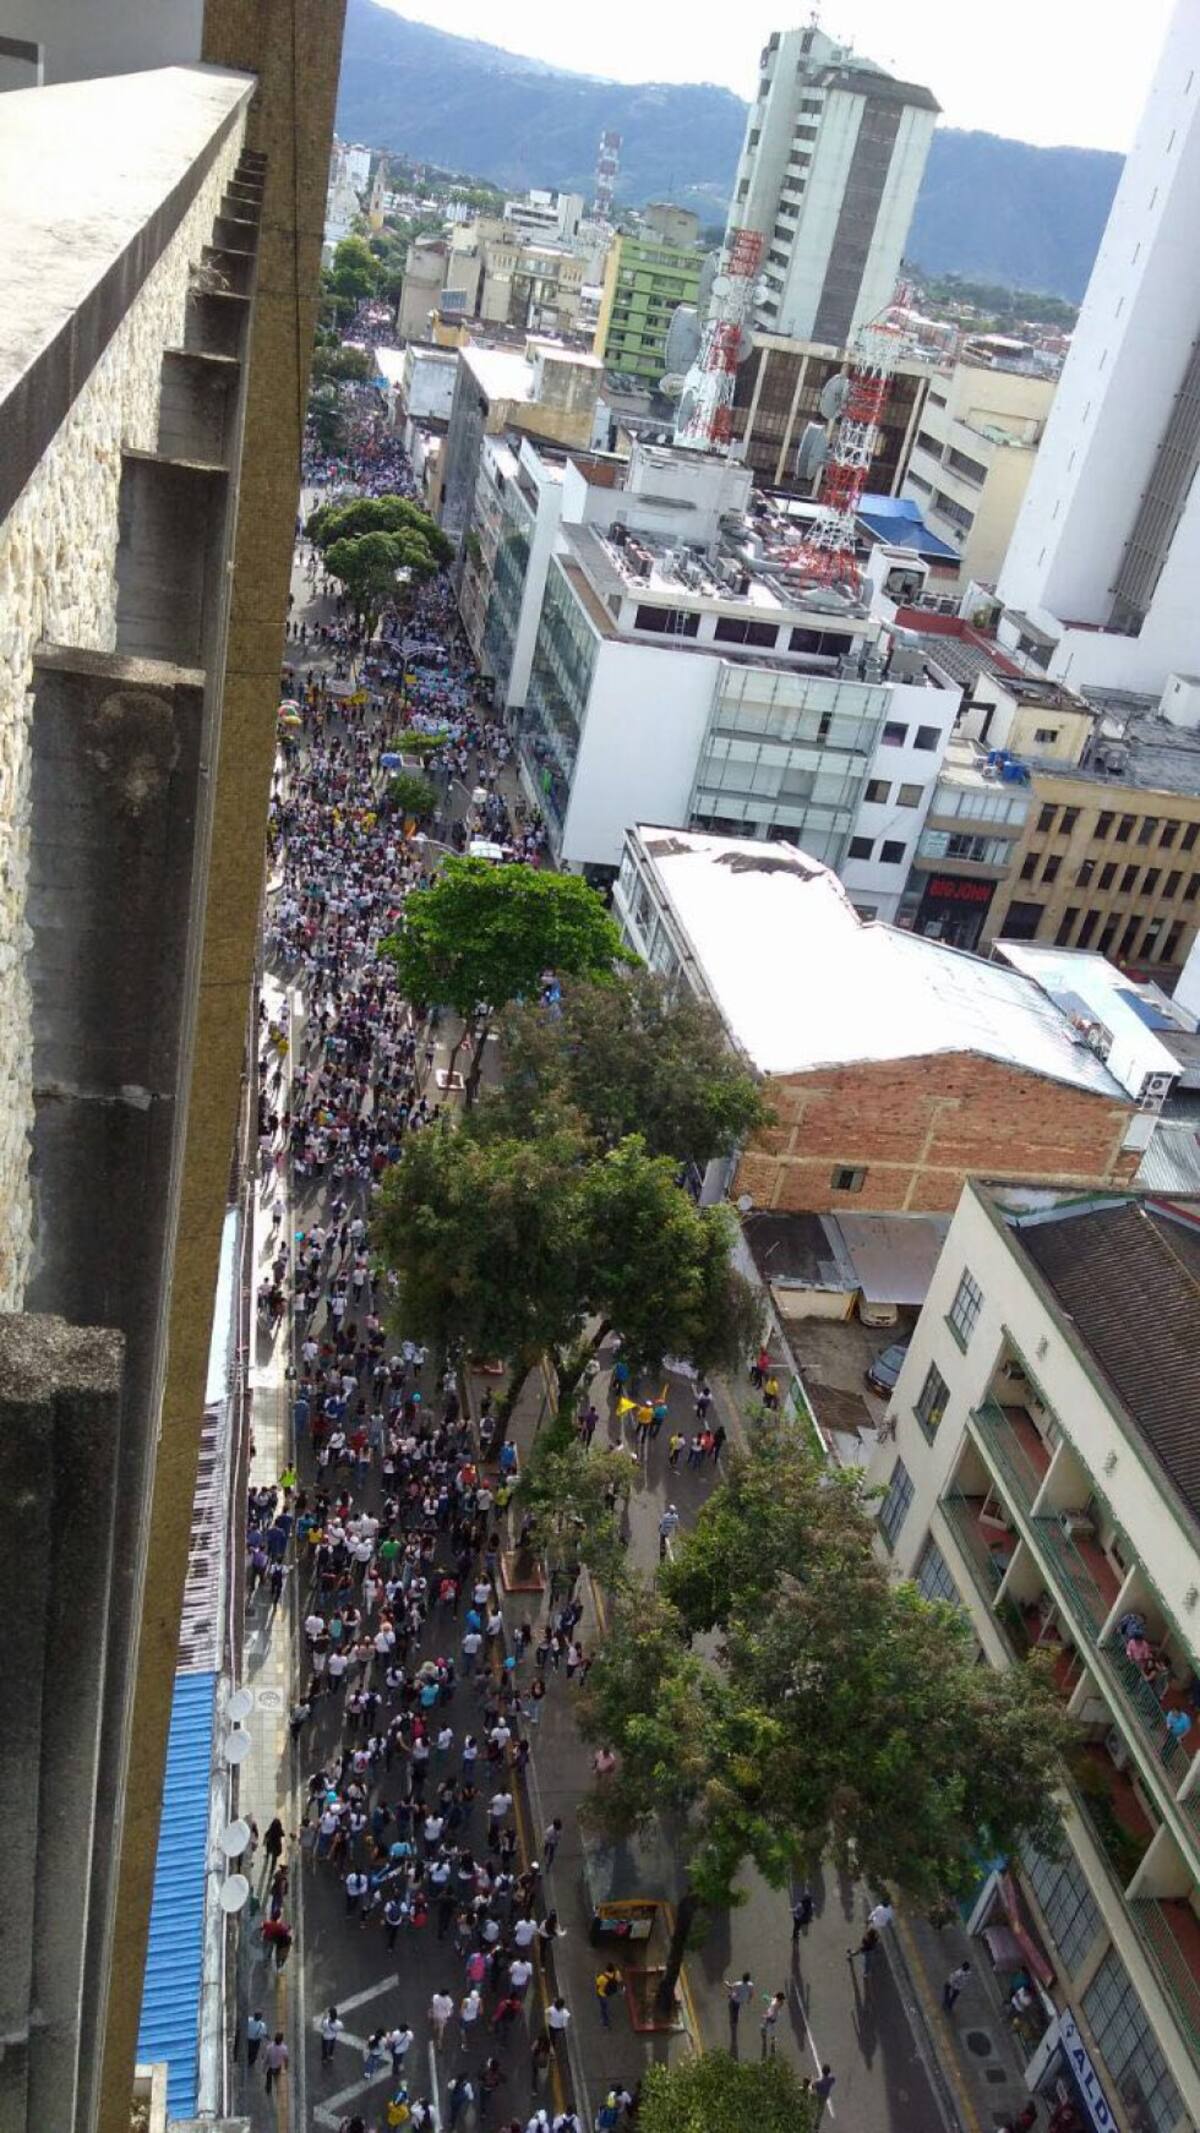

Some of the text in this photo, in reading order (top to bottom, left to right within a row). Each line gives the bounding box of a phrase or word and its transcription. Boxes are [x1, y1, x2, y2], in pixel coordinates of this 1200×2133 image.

[930, 880, 991, 902] BIG JOHN
[1072, 2048, 1117, 2133] ALD
